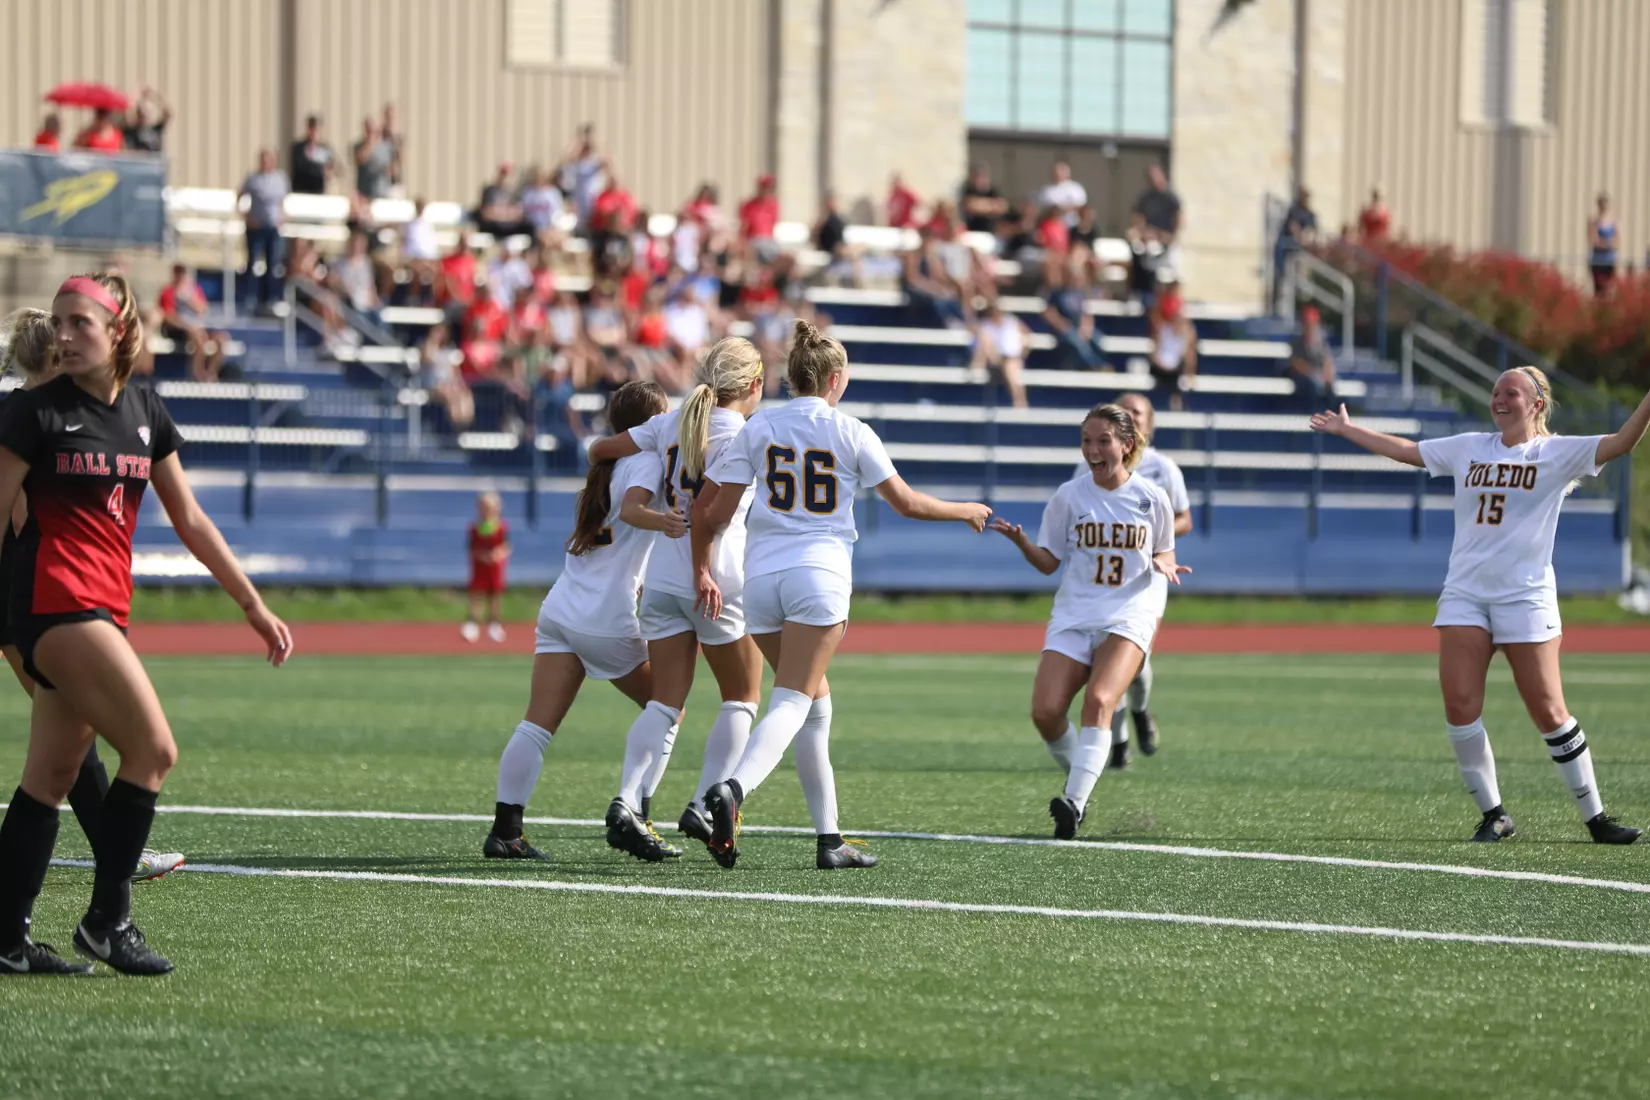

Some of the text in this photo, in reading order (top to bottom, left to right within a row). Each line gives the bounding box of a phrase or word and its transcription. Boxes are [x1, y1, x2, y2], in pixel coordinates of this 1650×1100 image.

[56, 452, 111, 475] BALL
[766, 443, 837, 515] 66
[1465, 463, 1537, 491] TOLEDO
[108, 482, 125, 526] 4
[1476, 492, 1505, 526] 15
[1075, 521, 1147, 550] TOLEDO
[1094, 553, 1125, 588] 13
